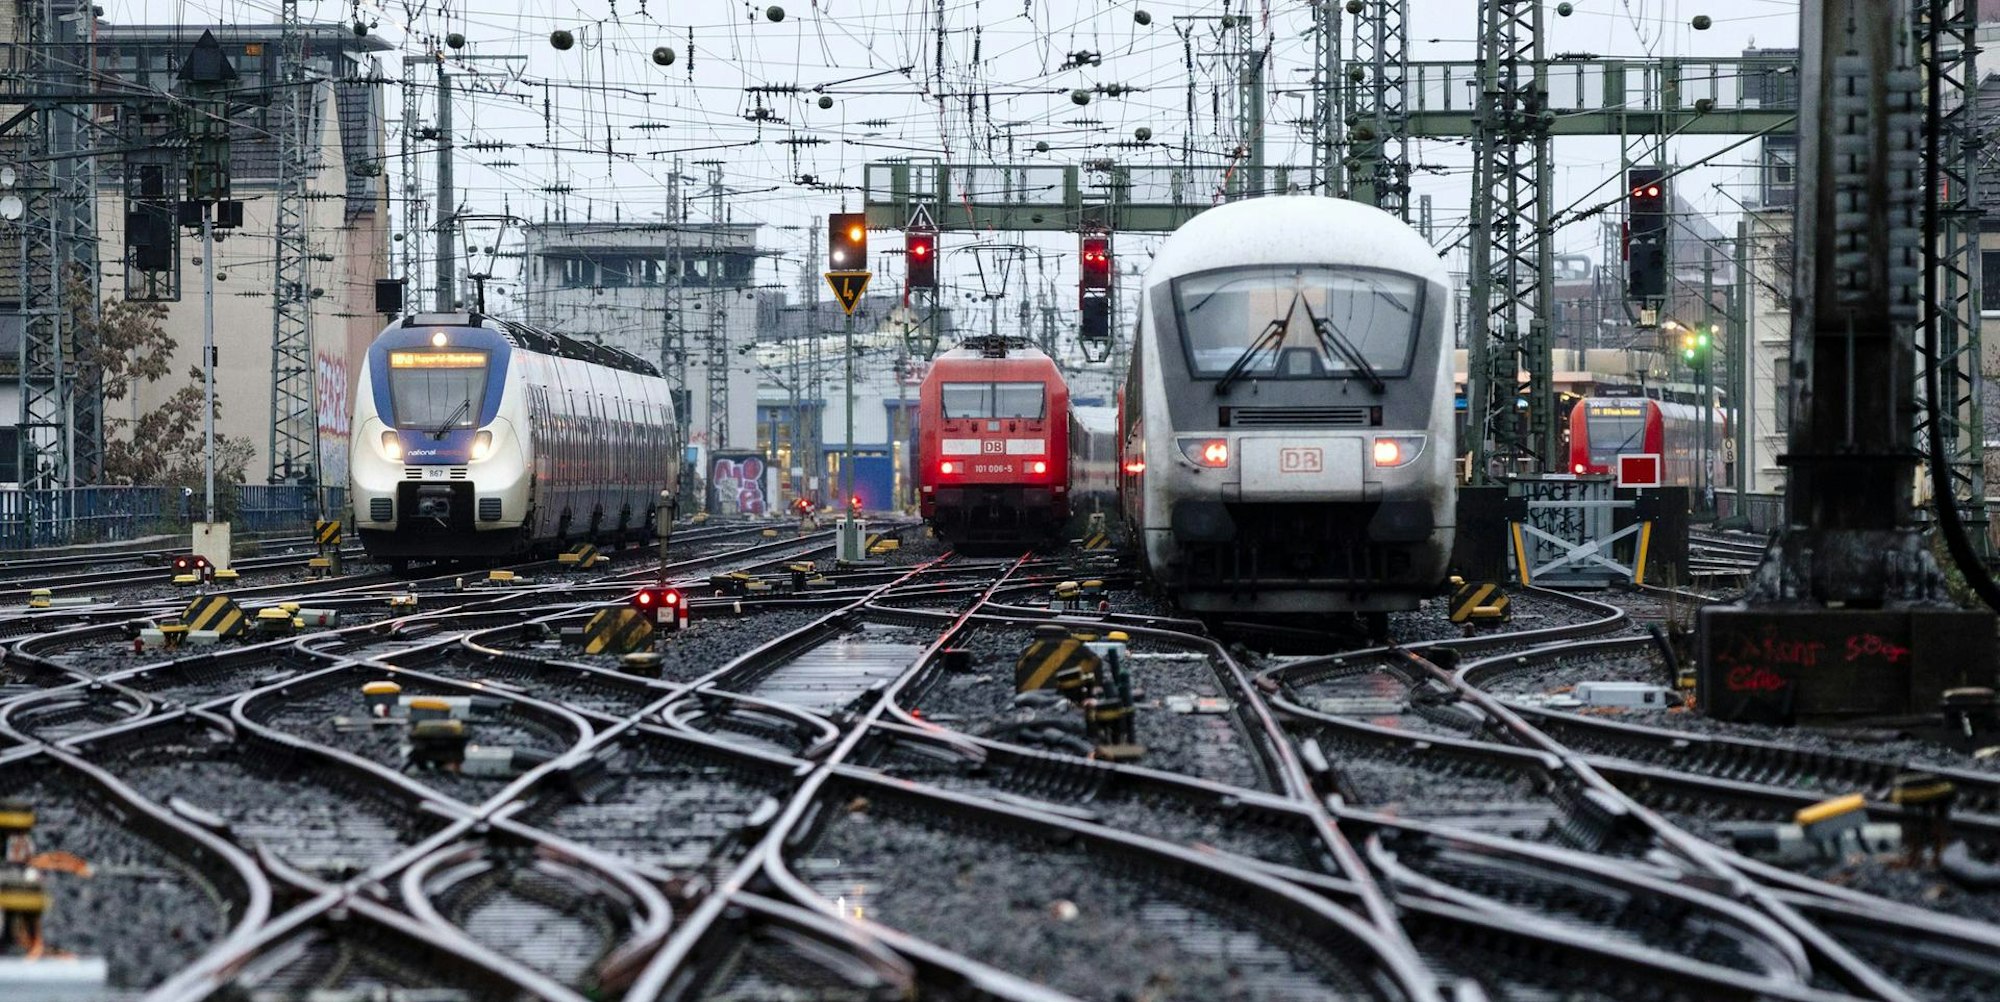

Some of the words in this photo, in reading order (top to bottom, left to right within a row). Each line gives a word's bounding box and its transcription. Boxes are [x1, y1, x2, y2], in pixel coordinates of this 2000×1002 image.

[918, 213, 926, 229] 4
[843, 277, 854, 300] 4
[985, 441, 1003, 452] DB
[1285, 451, 1319, 469] DB
[429, 470, 444, 478] 867
[975, 464, 987, 473] 101
